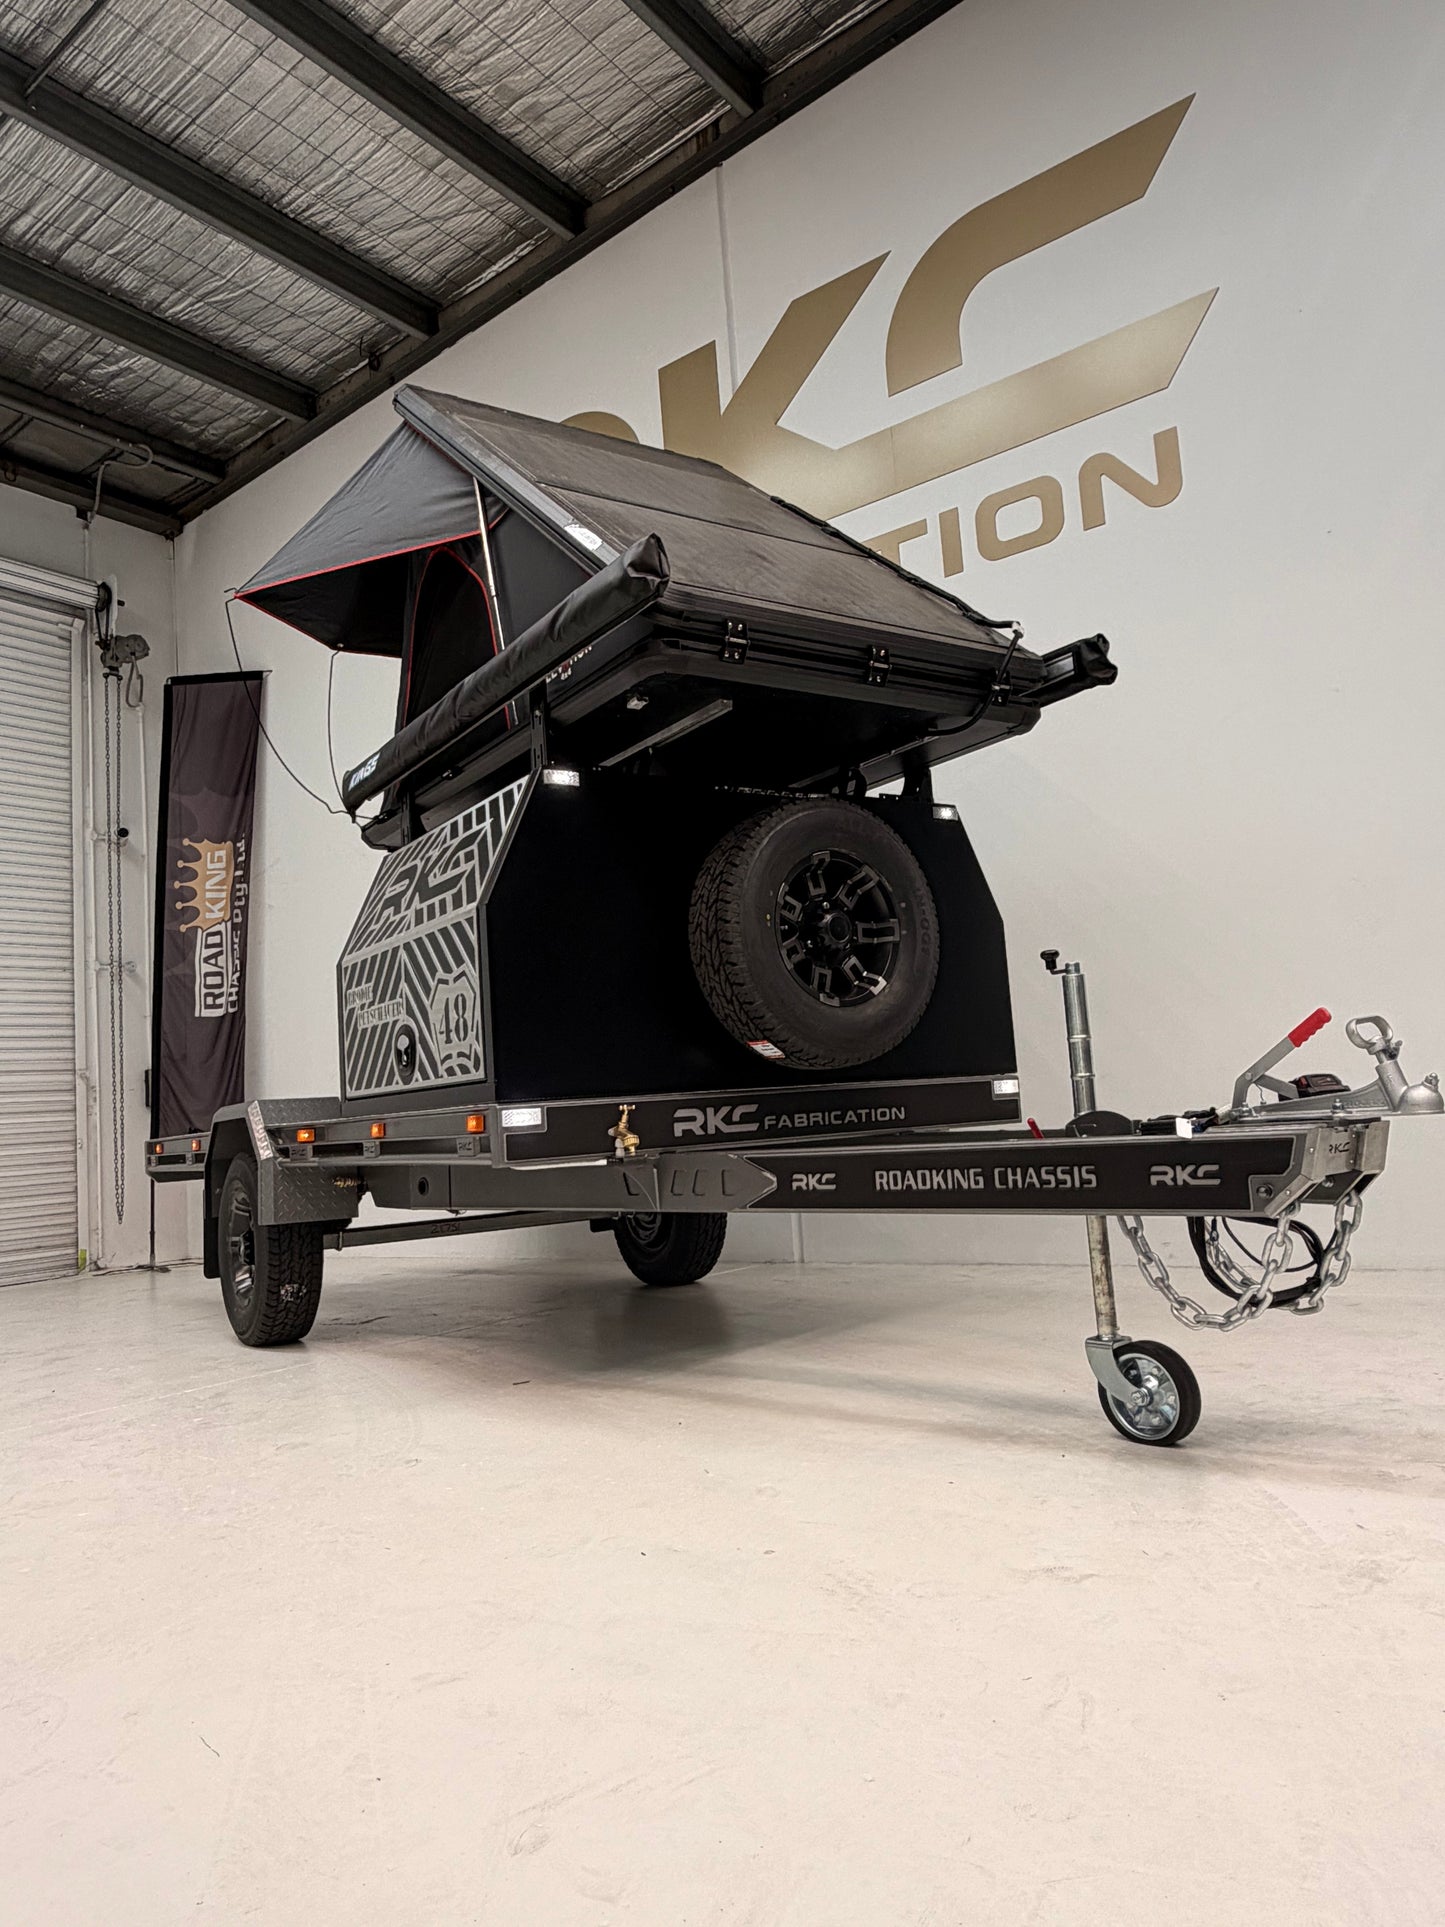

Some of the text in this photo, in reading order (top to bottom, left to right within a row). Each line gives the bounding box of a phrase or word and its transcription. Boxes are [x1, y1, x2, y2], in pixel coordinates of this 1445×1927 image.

[559, 92, 1219, 520] KC
[203, 849, 228, 1011] ROAD KING
[438, 992, 469, 1045] 48
[673, 1104, 906, 1137] RKC FABRICATION
[791, 1173, 837, 1191] RKC
[874, 1165, 1097, 1191] ROADKING CHASSIS
[1150, 1164, 1221, 1187] RKC
